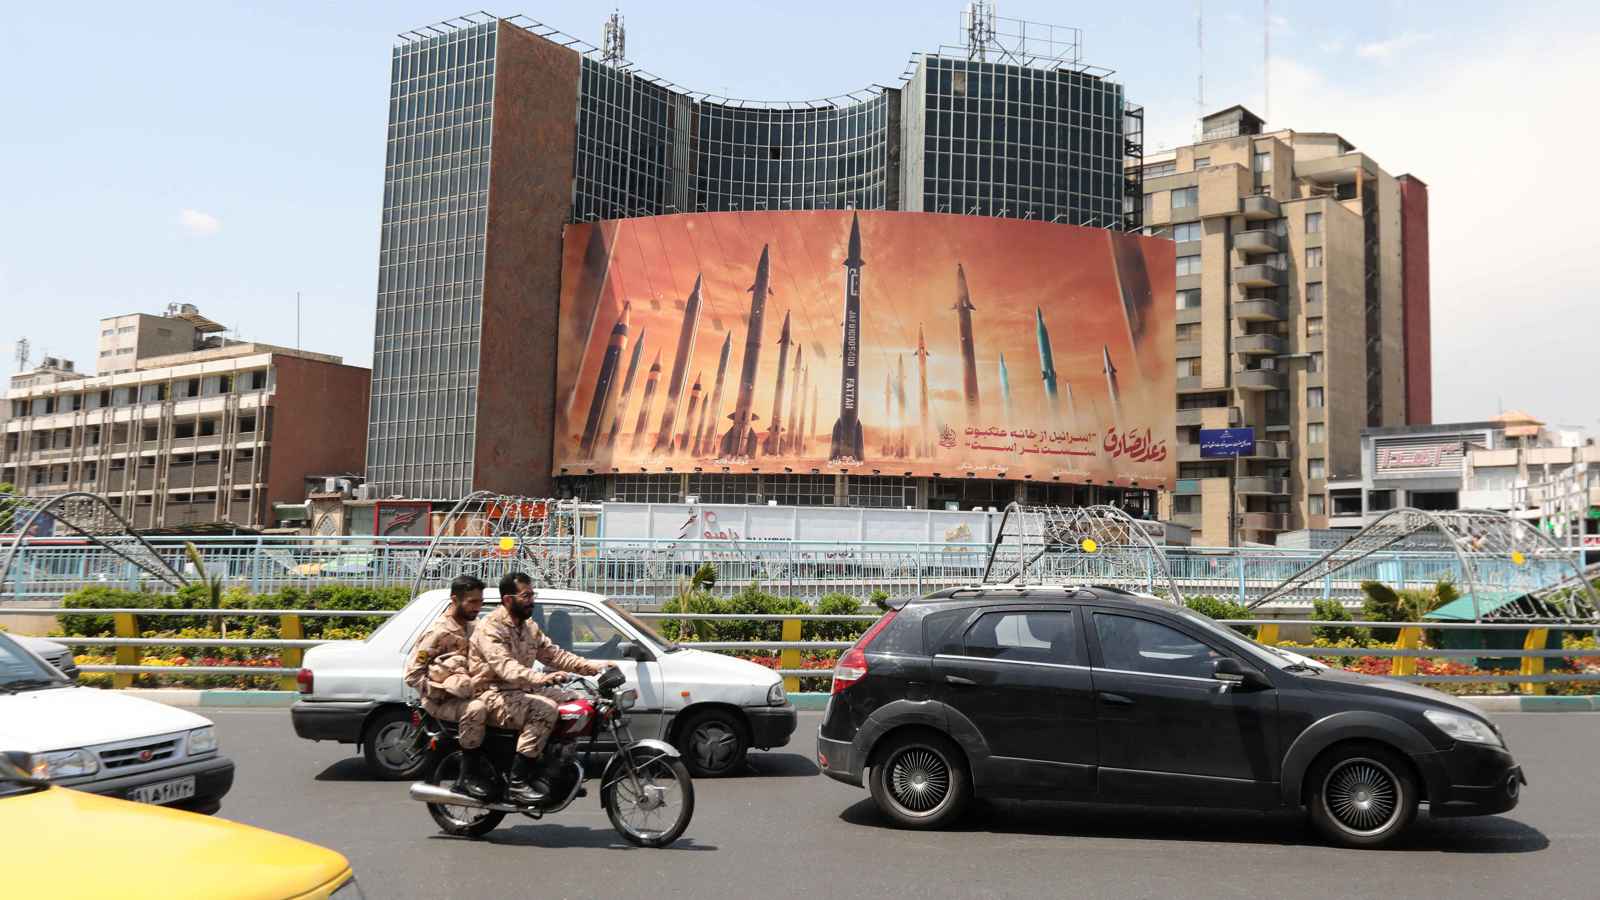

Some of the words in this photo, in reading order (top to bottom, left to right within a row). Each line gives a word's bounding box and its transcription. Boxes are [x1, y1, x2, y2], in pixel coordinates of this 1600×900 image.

[848, 268, 859, 296] فتاح
[845, 378, 855, 409] FATTAH
[964, 425, 1007, 440] عنکبوت
[1010, 429, 1038, 440] خانه
[1039, 430, 1048, 443] از
